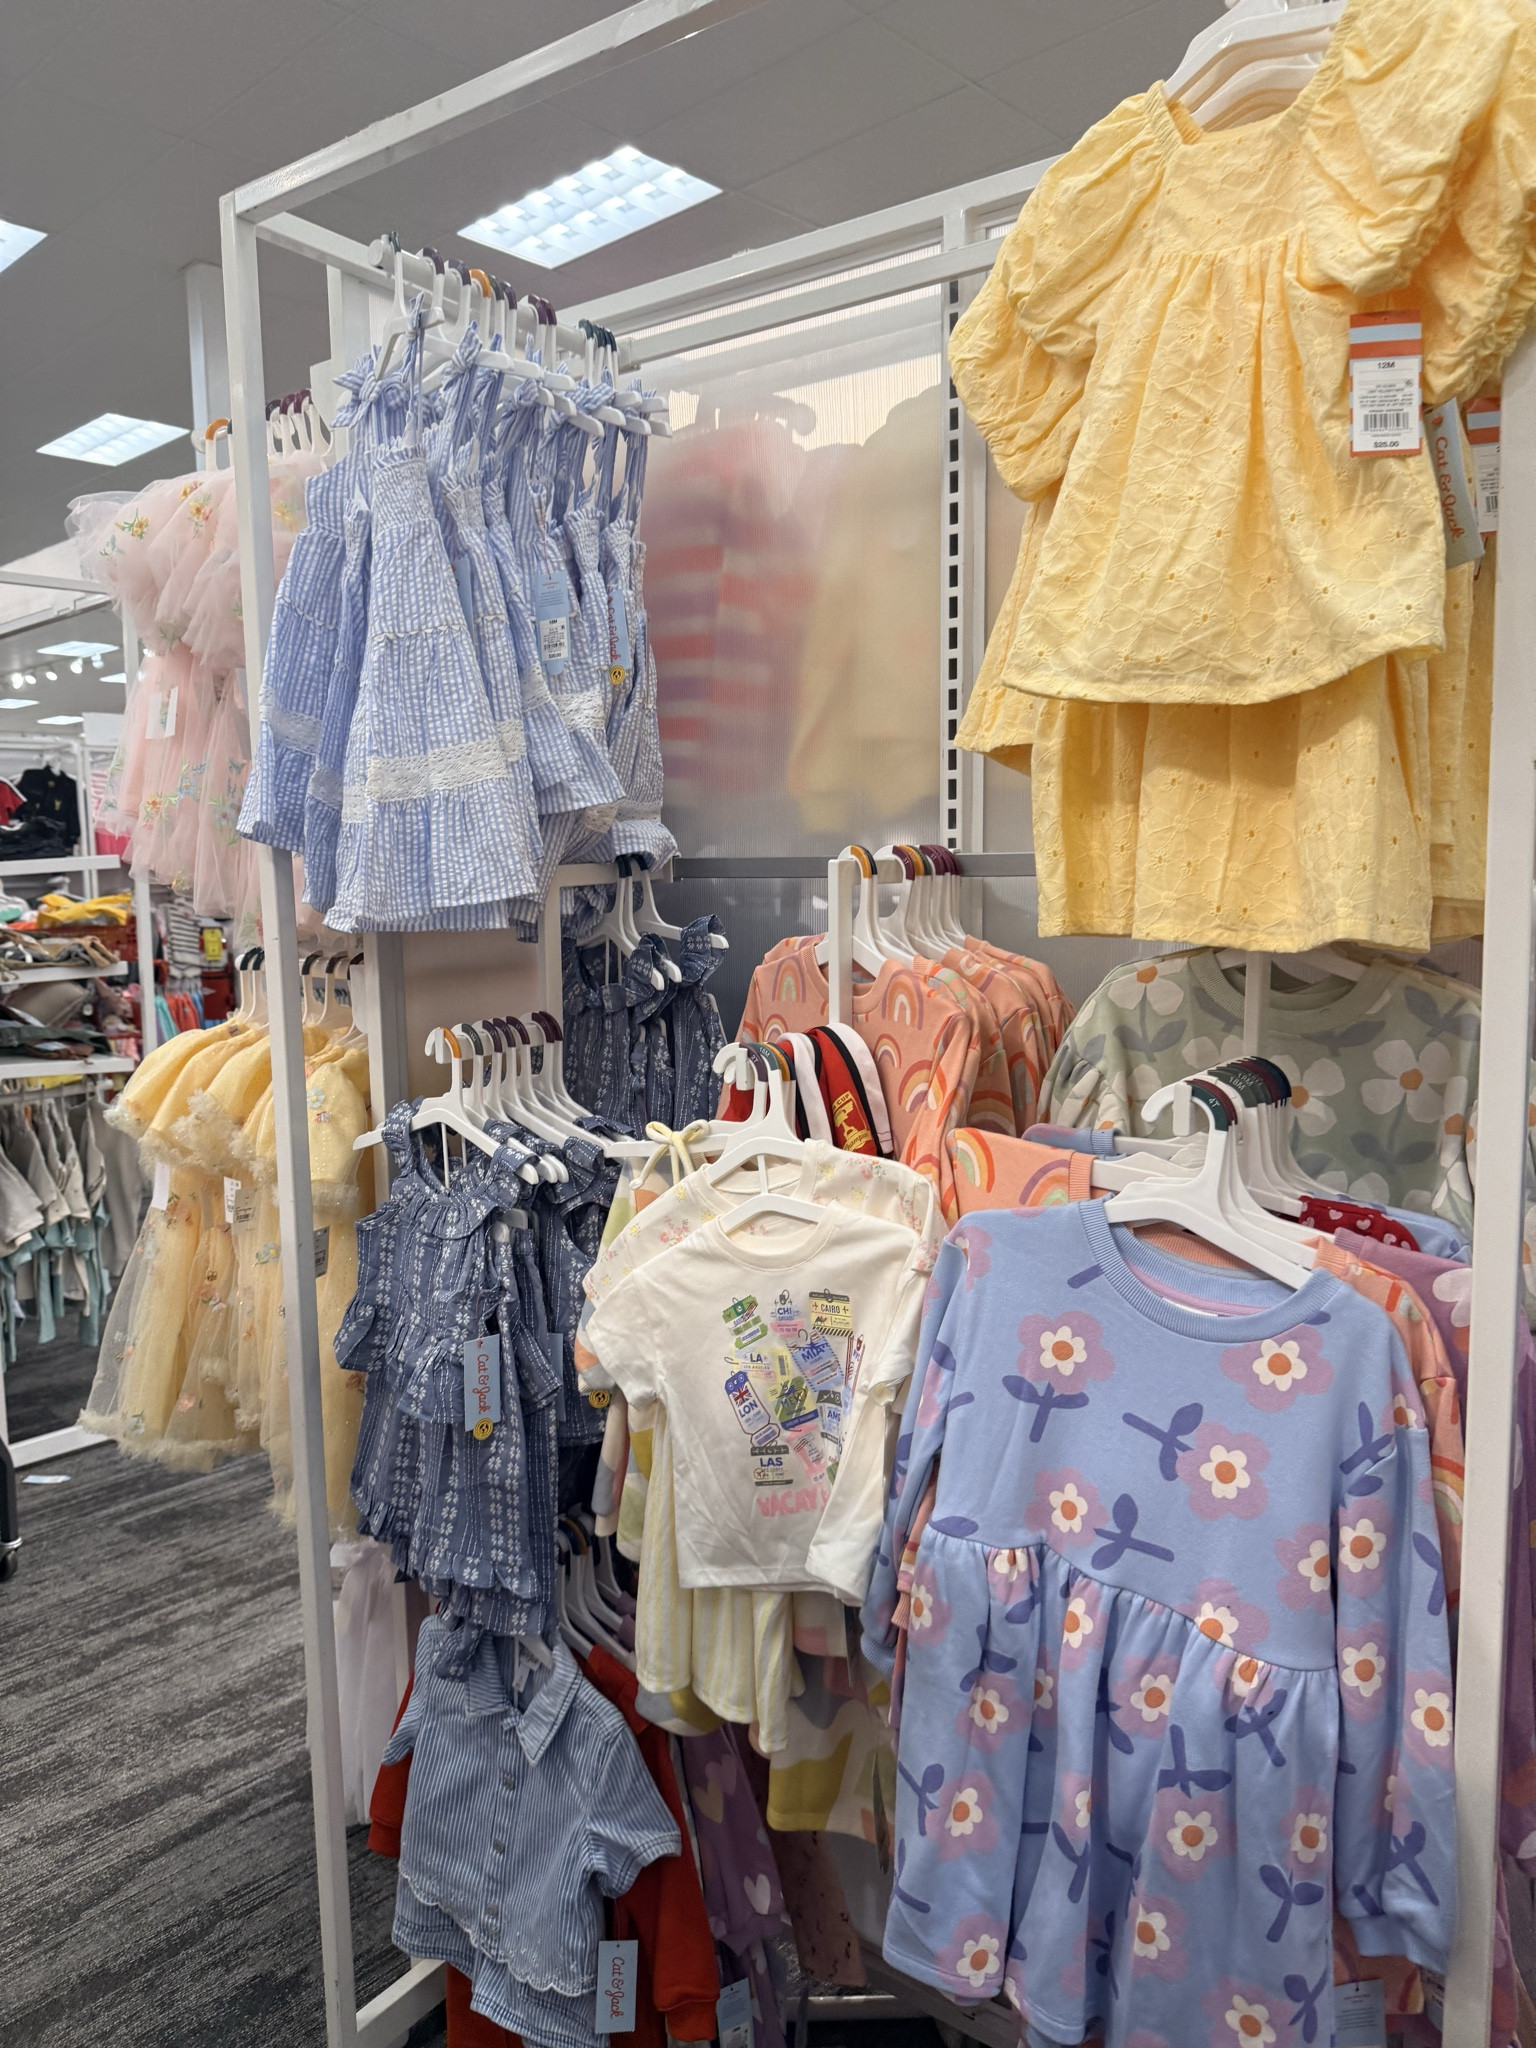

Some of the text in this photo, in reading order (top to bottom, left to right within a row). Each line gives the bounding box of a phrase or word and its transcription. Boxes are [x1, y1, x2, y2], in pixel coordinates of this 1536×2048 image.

[1373, 440, 1400, 449] $25.00
[1435, 436, 1449, 469] Cat
[1442, 494, 1466, 543] Jack
[608, 607, 616, 623] Cat
[1229, 1076, 1246, 1091] 18M
[836, 1093, 850, 1105] CUP
[1208, 1098, 1220, 1108] 4T
[777, 1307, 792, 1315] CHI
[820, 1303, 841, 1314] CAIRO
[750, 1353, 763, 1363] LA
[801, 1346, 825, 1362] MIA
[477, 1353, 490, 1374] Cat
[472, 1386, 492, 1415] Jack
[738, 1400, 758, 1418] LON
[760, 1457, 783, 1468] LAS
[756, 1486, 817, 1517] VACAY
[611, 1956, 625, 1976] Cat
[605, 1989, 625, 2019] Jack
